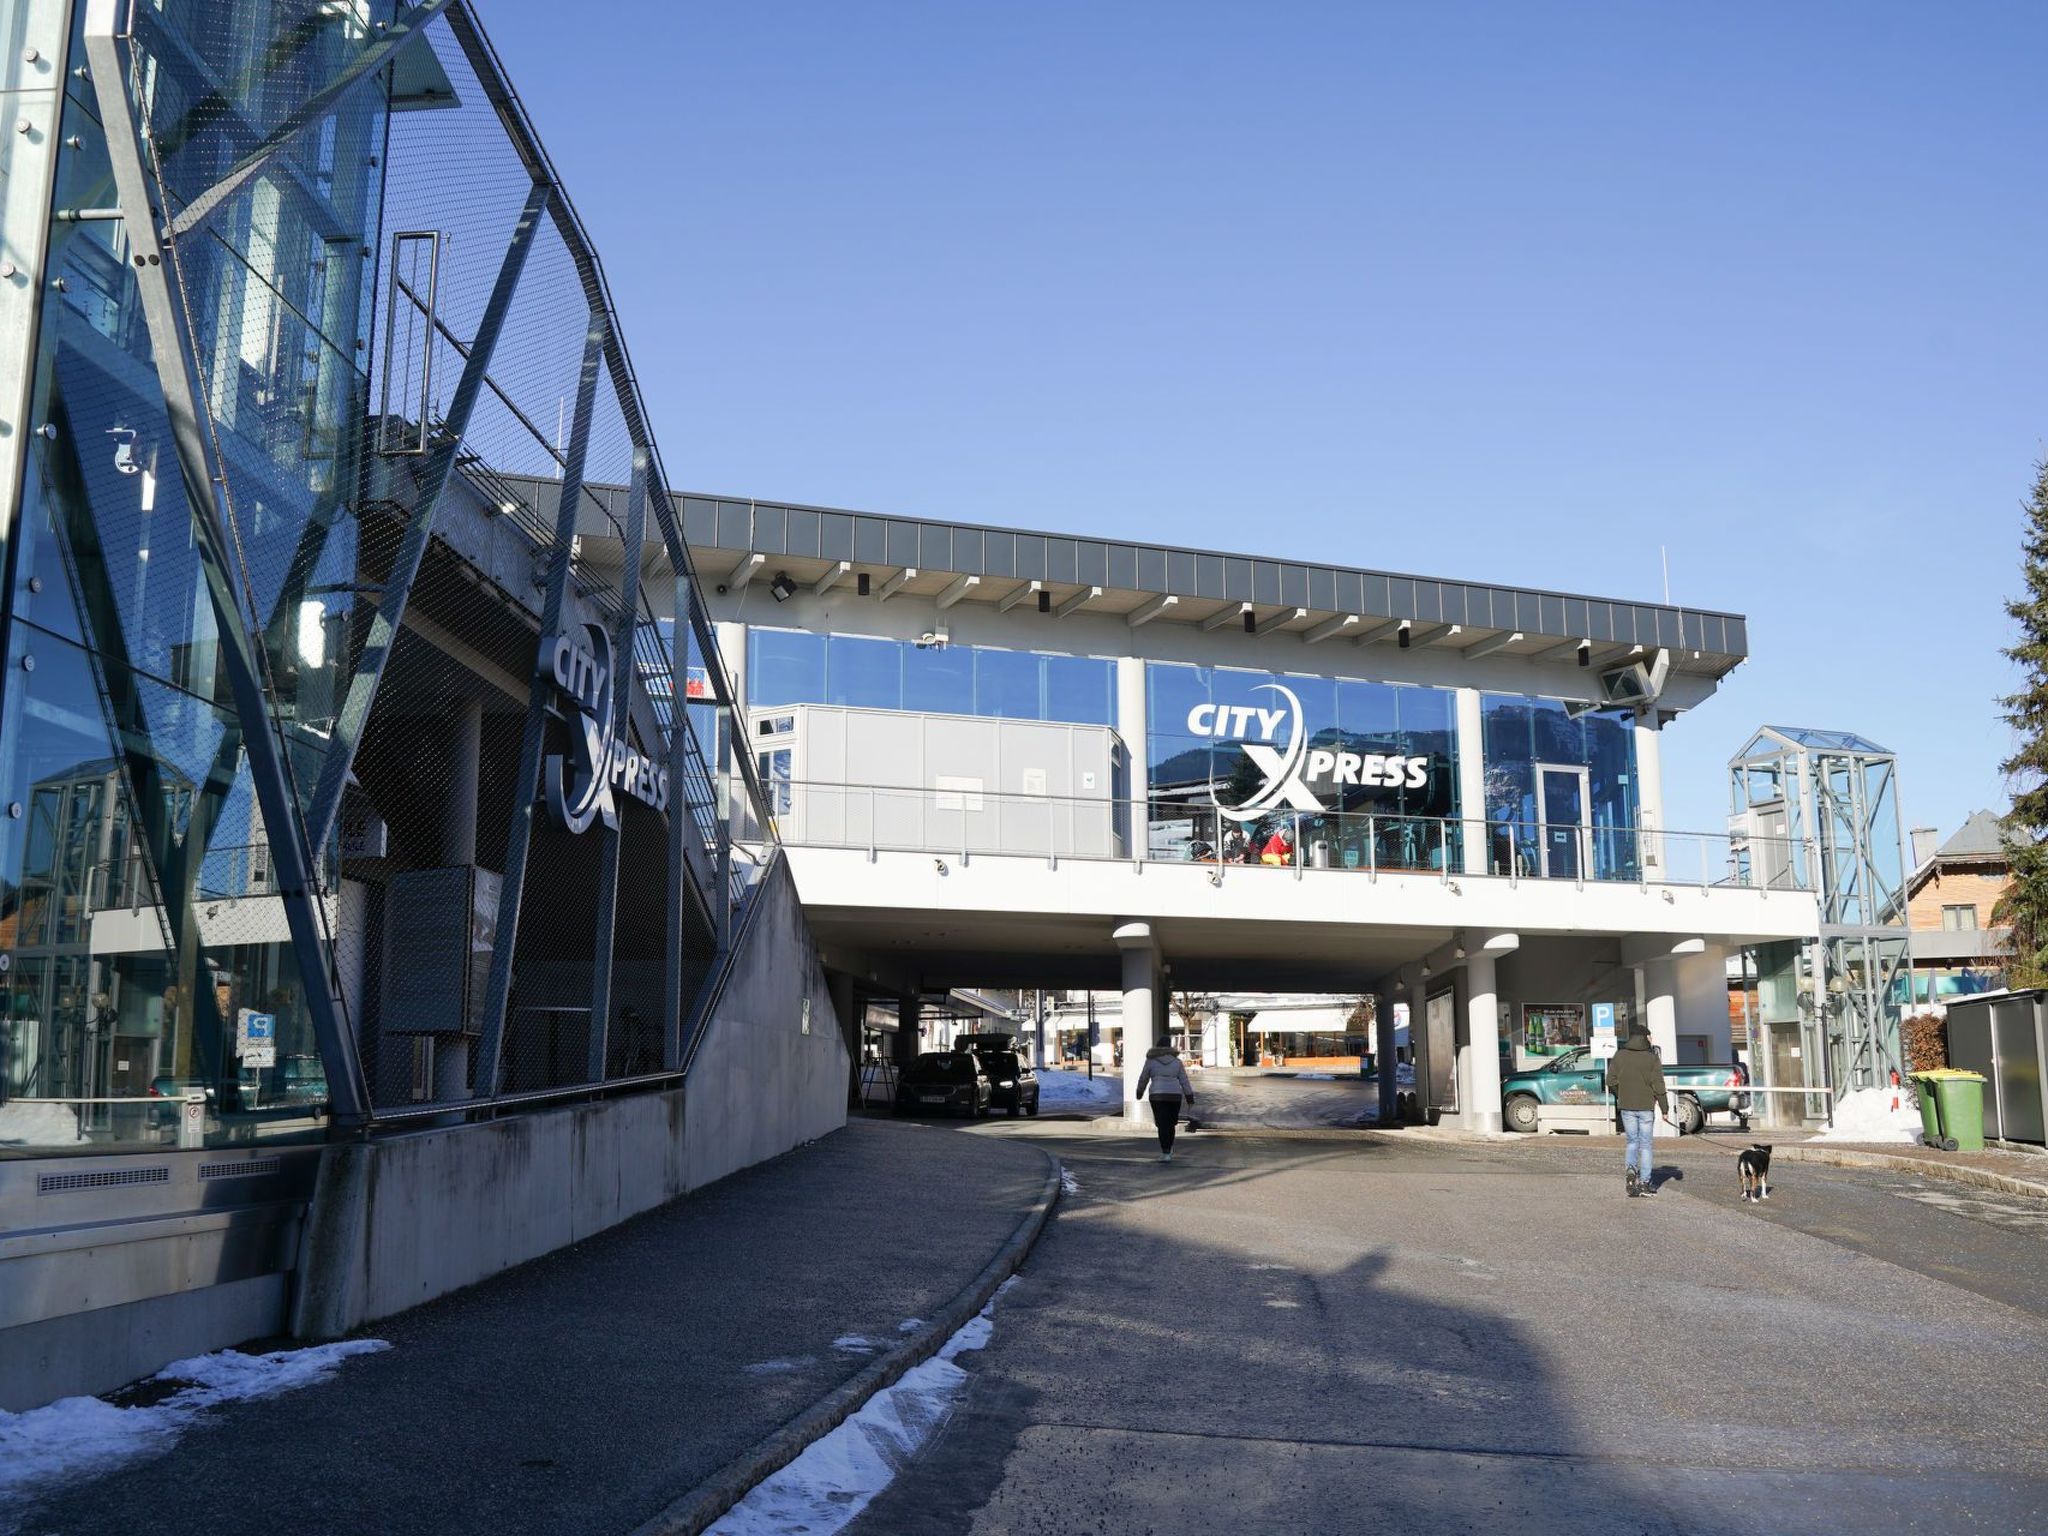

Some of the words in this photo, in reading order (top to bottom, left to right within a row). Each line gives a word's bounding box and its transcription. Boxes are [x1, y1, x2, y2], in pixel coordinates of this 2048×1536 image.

[554, 636, 606, 710] CITY
[1188, 703, 1286, 740] CITY
[1596, 1006, 1610, 1027] P
